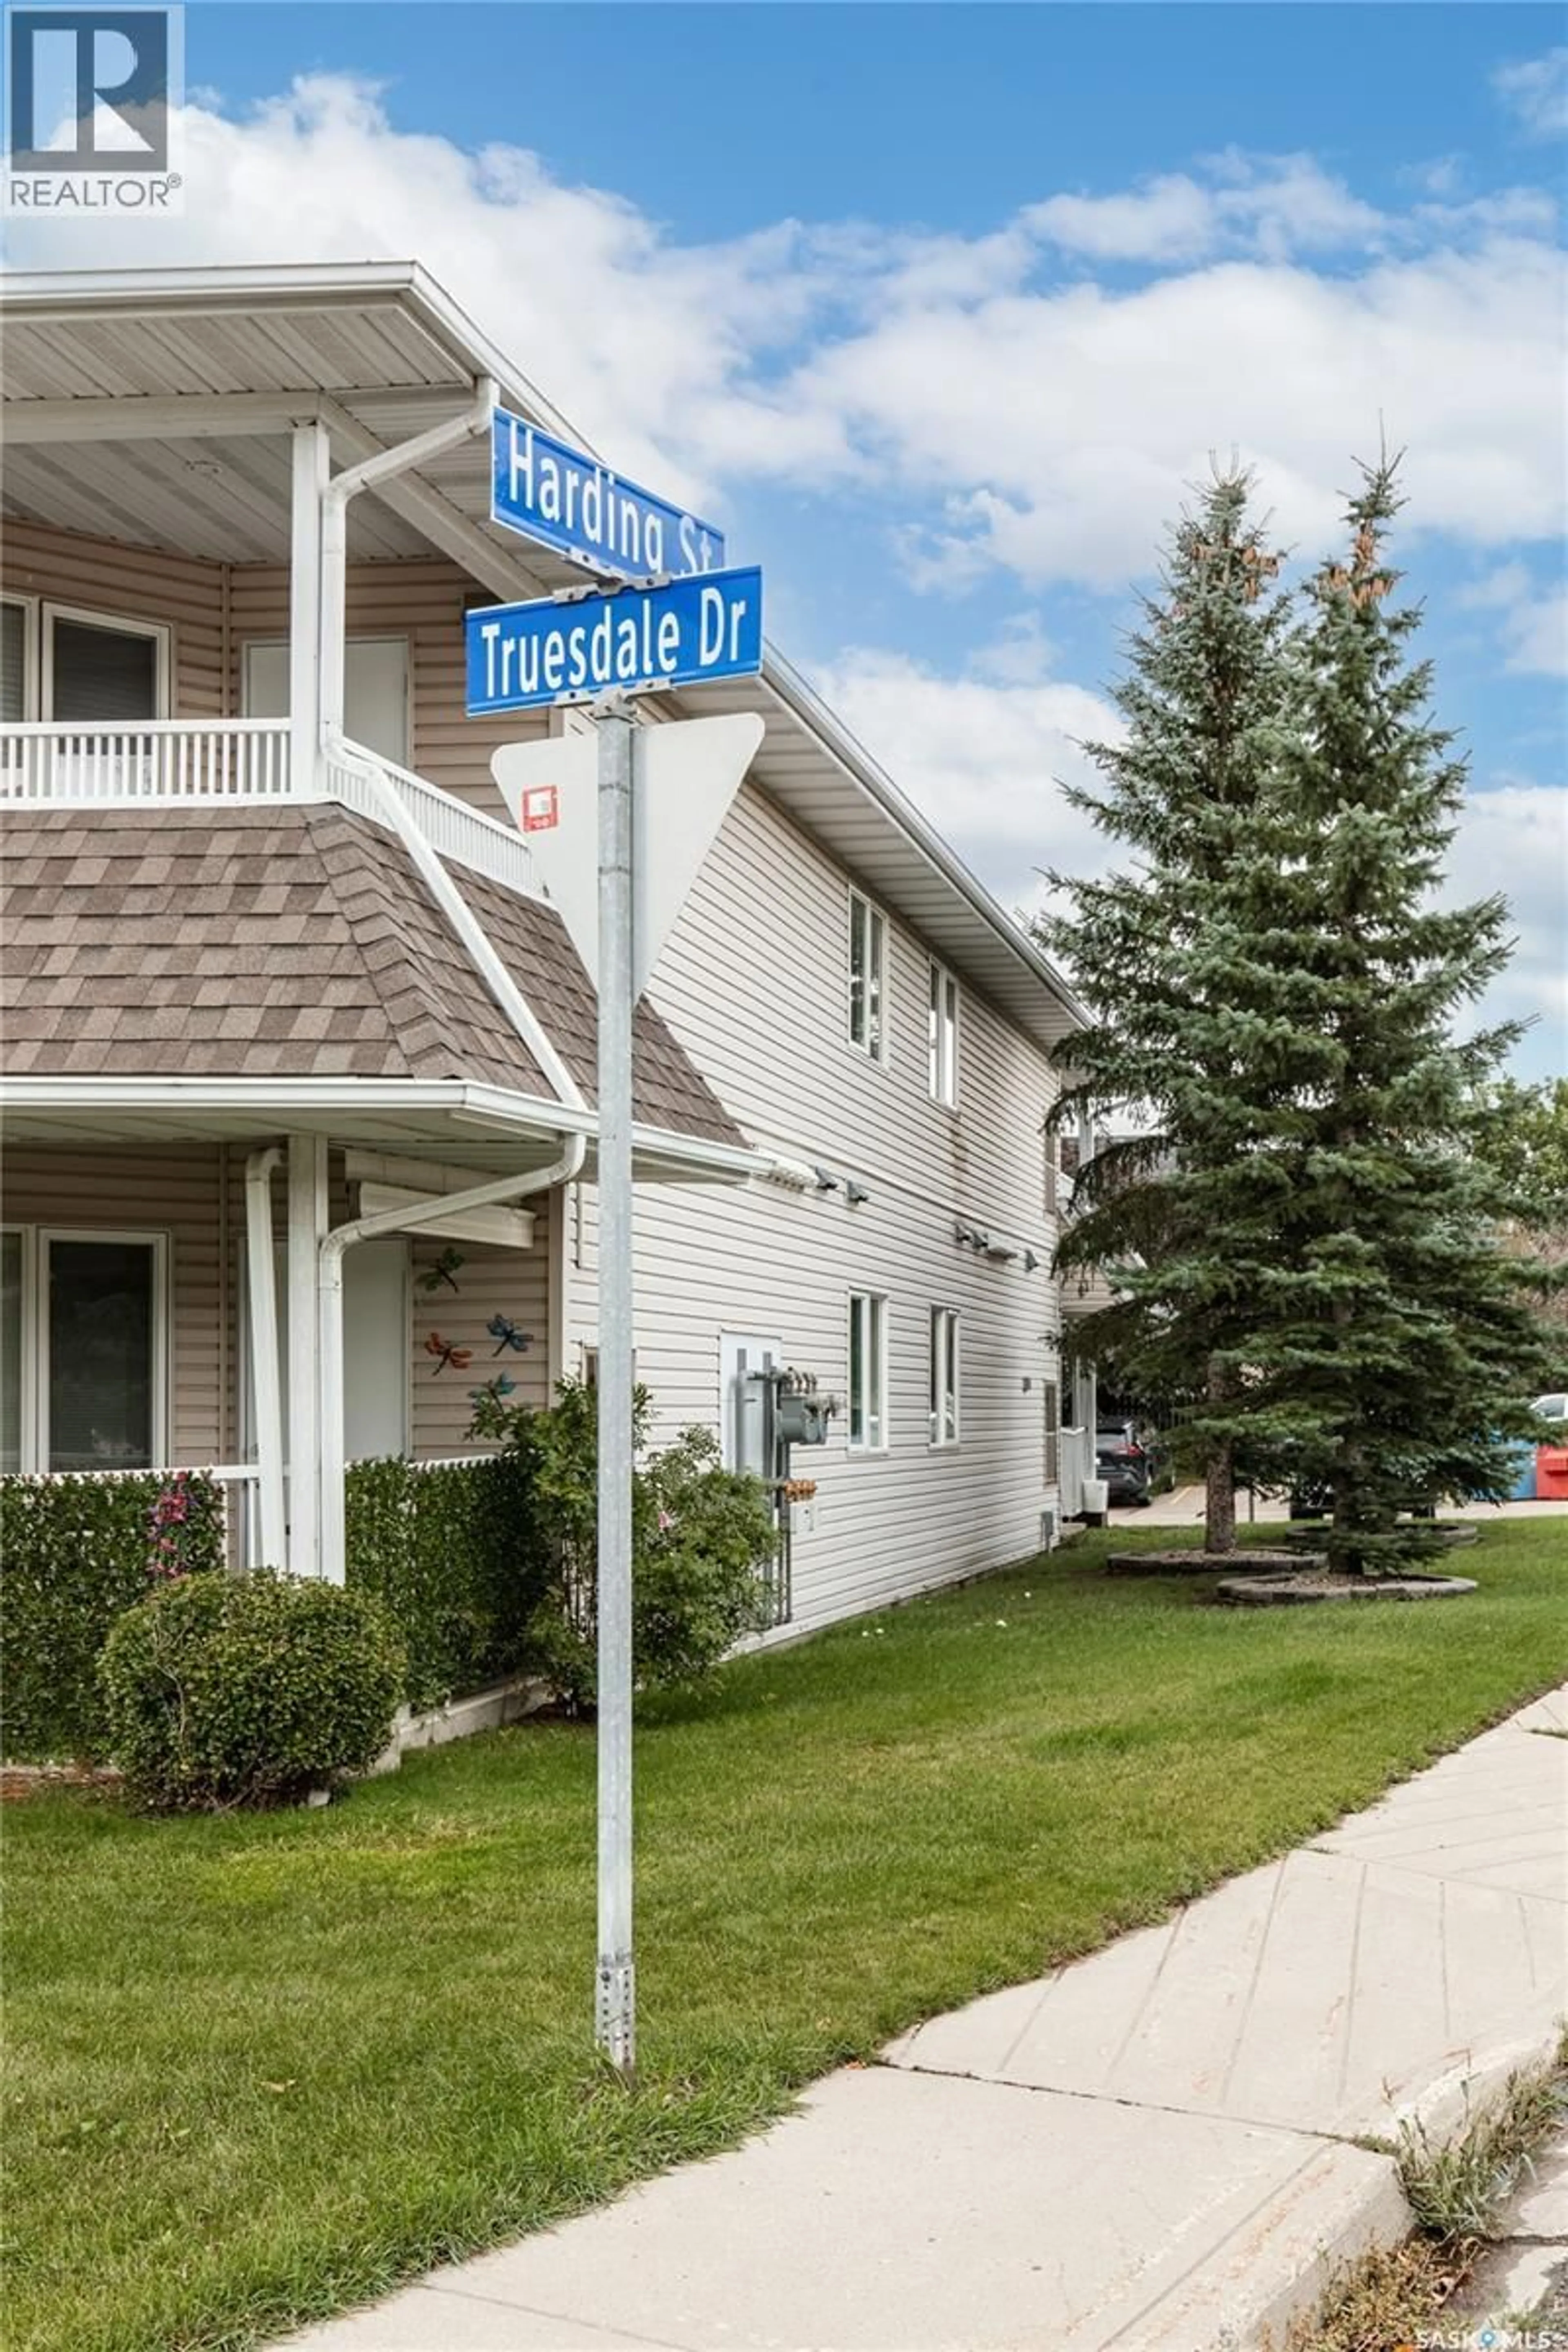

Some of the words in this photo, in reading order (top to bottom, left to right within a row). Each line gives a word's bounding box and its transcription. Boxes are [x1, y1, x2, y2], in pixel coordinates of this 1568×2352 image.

[510, 420, 664, 575] Harding
[679, 515, 712, 576] St
[481, 599, 679, 697] Truesdale
[699, 587, 746, 666] Dr
